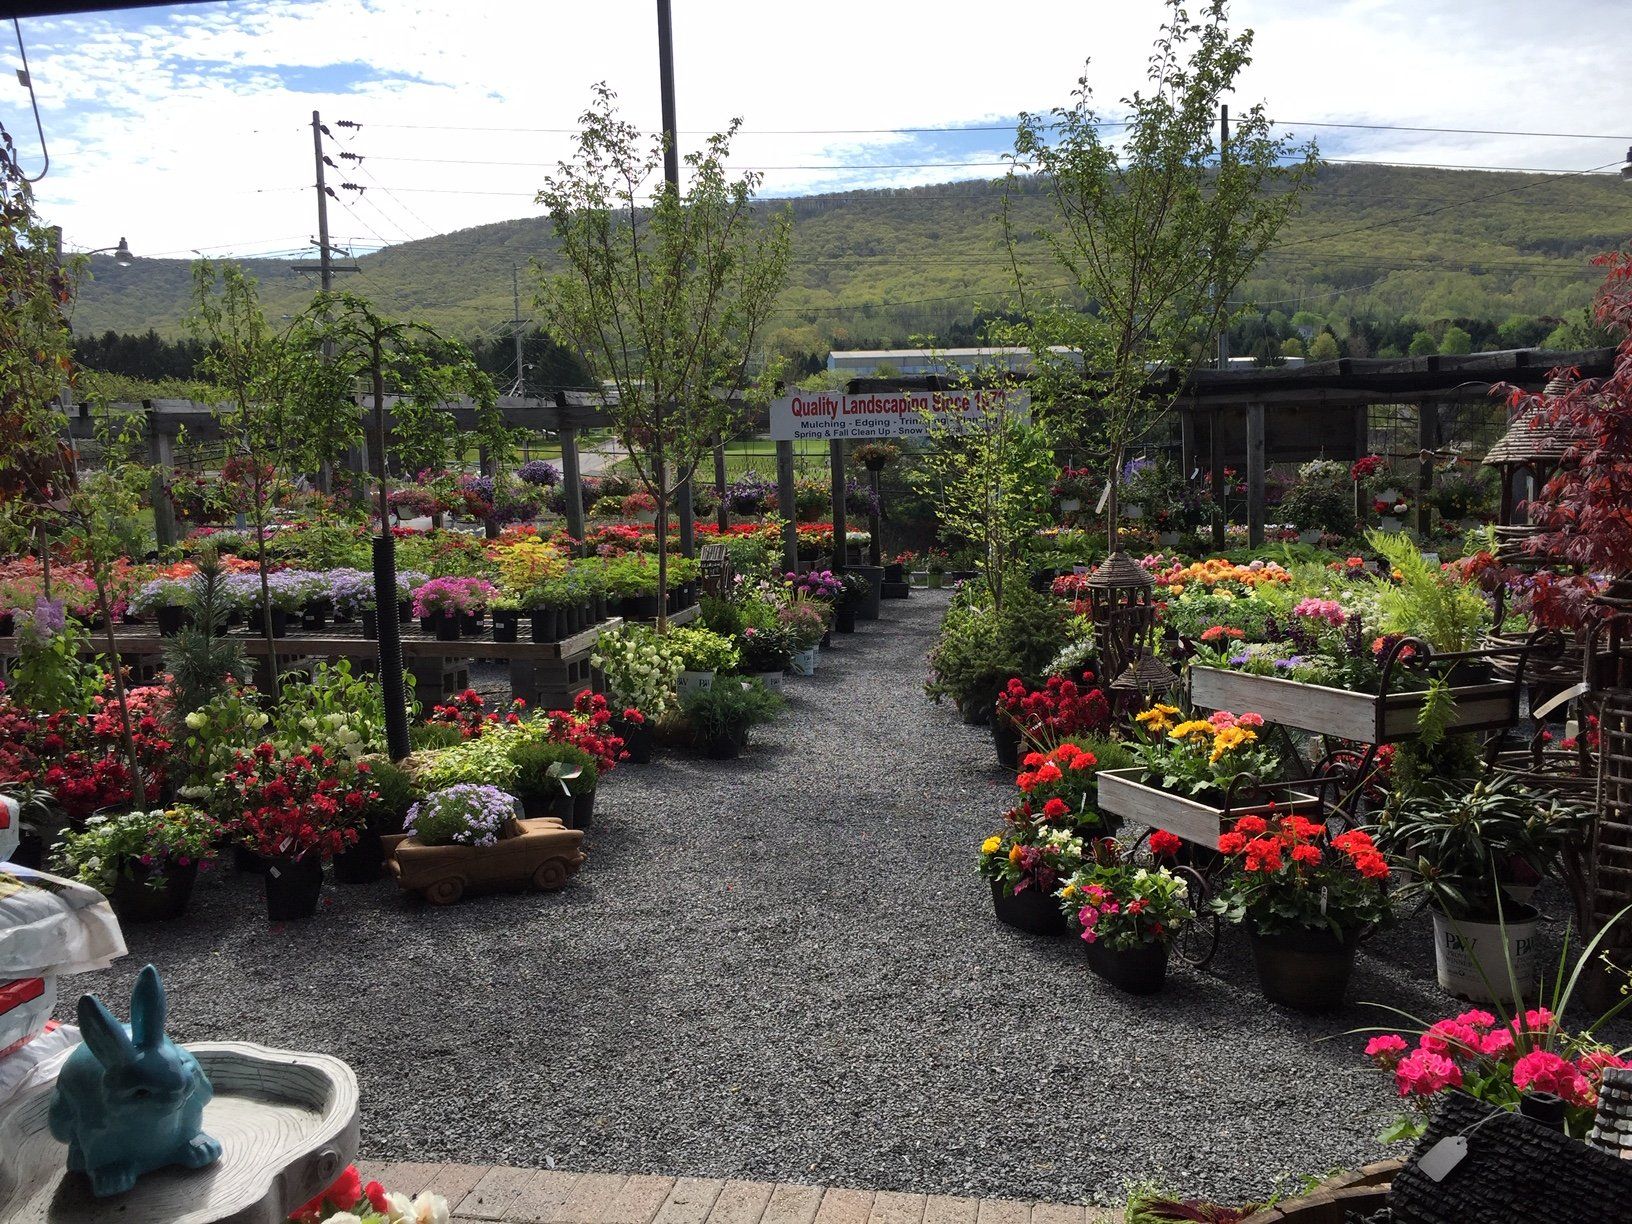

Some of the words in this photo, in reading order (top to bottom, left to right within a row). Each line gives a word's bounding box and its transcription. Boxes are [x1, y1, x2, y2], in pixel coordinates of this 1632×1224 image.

[792, 397, 838, 420] Quality
[842, 395, 928, 417] Landscaping
[932, 392, 970, 413] Since
[800, 420, 846, 429] Mulching
[855, 418, 890, 428] Edging
[794, 430, 822, 439] Spring
[824, 429, 831, 437] &
[833, 428, 849, 437] Fall
[851, 427, 876, 436] Clean
[878, 427, 891, 437] Up
[898, 426, 923, 435] Snow
